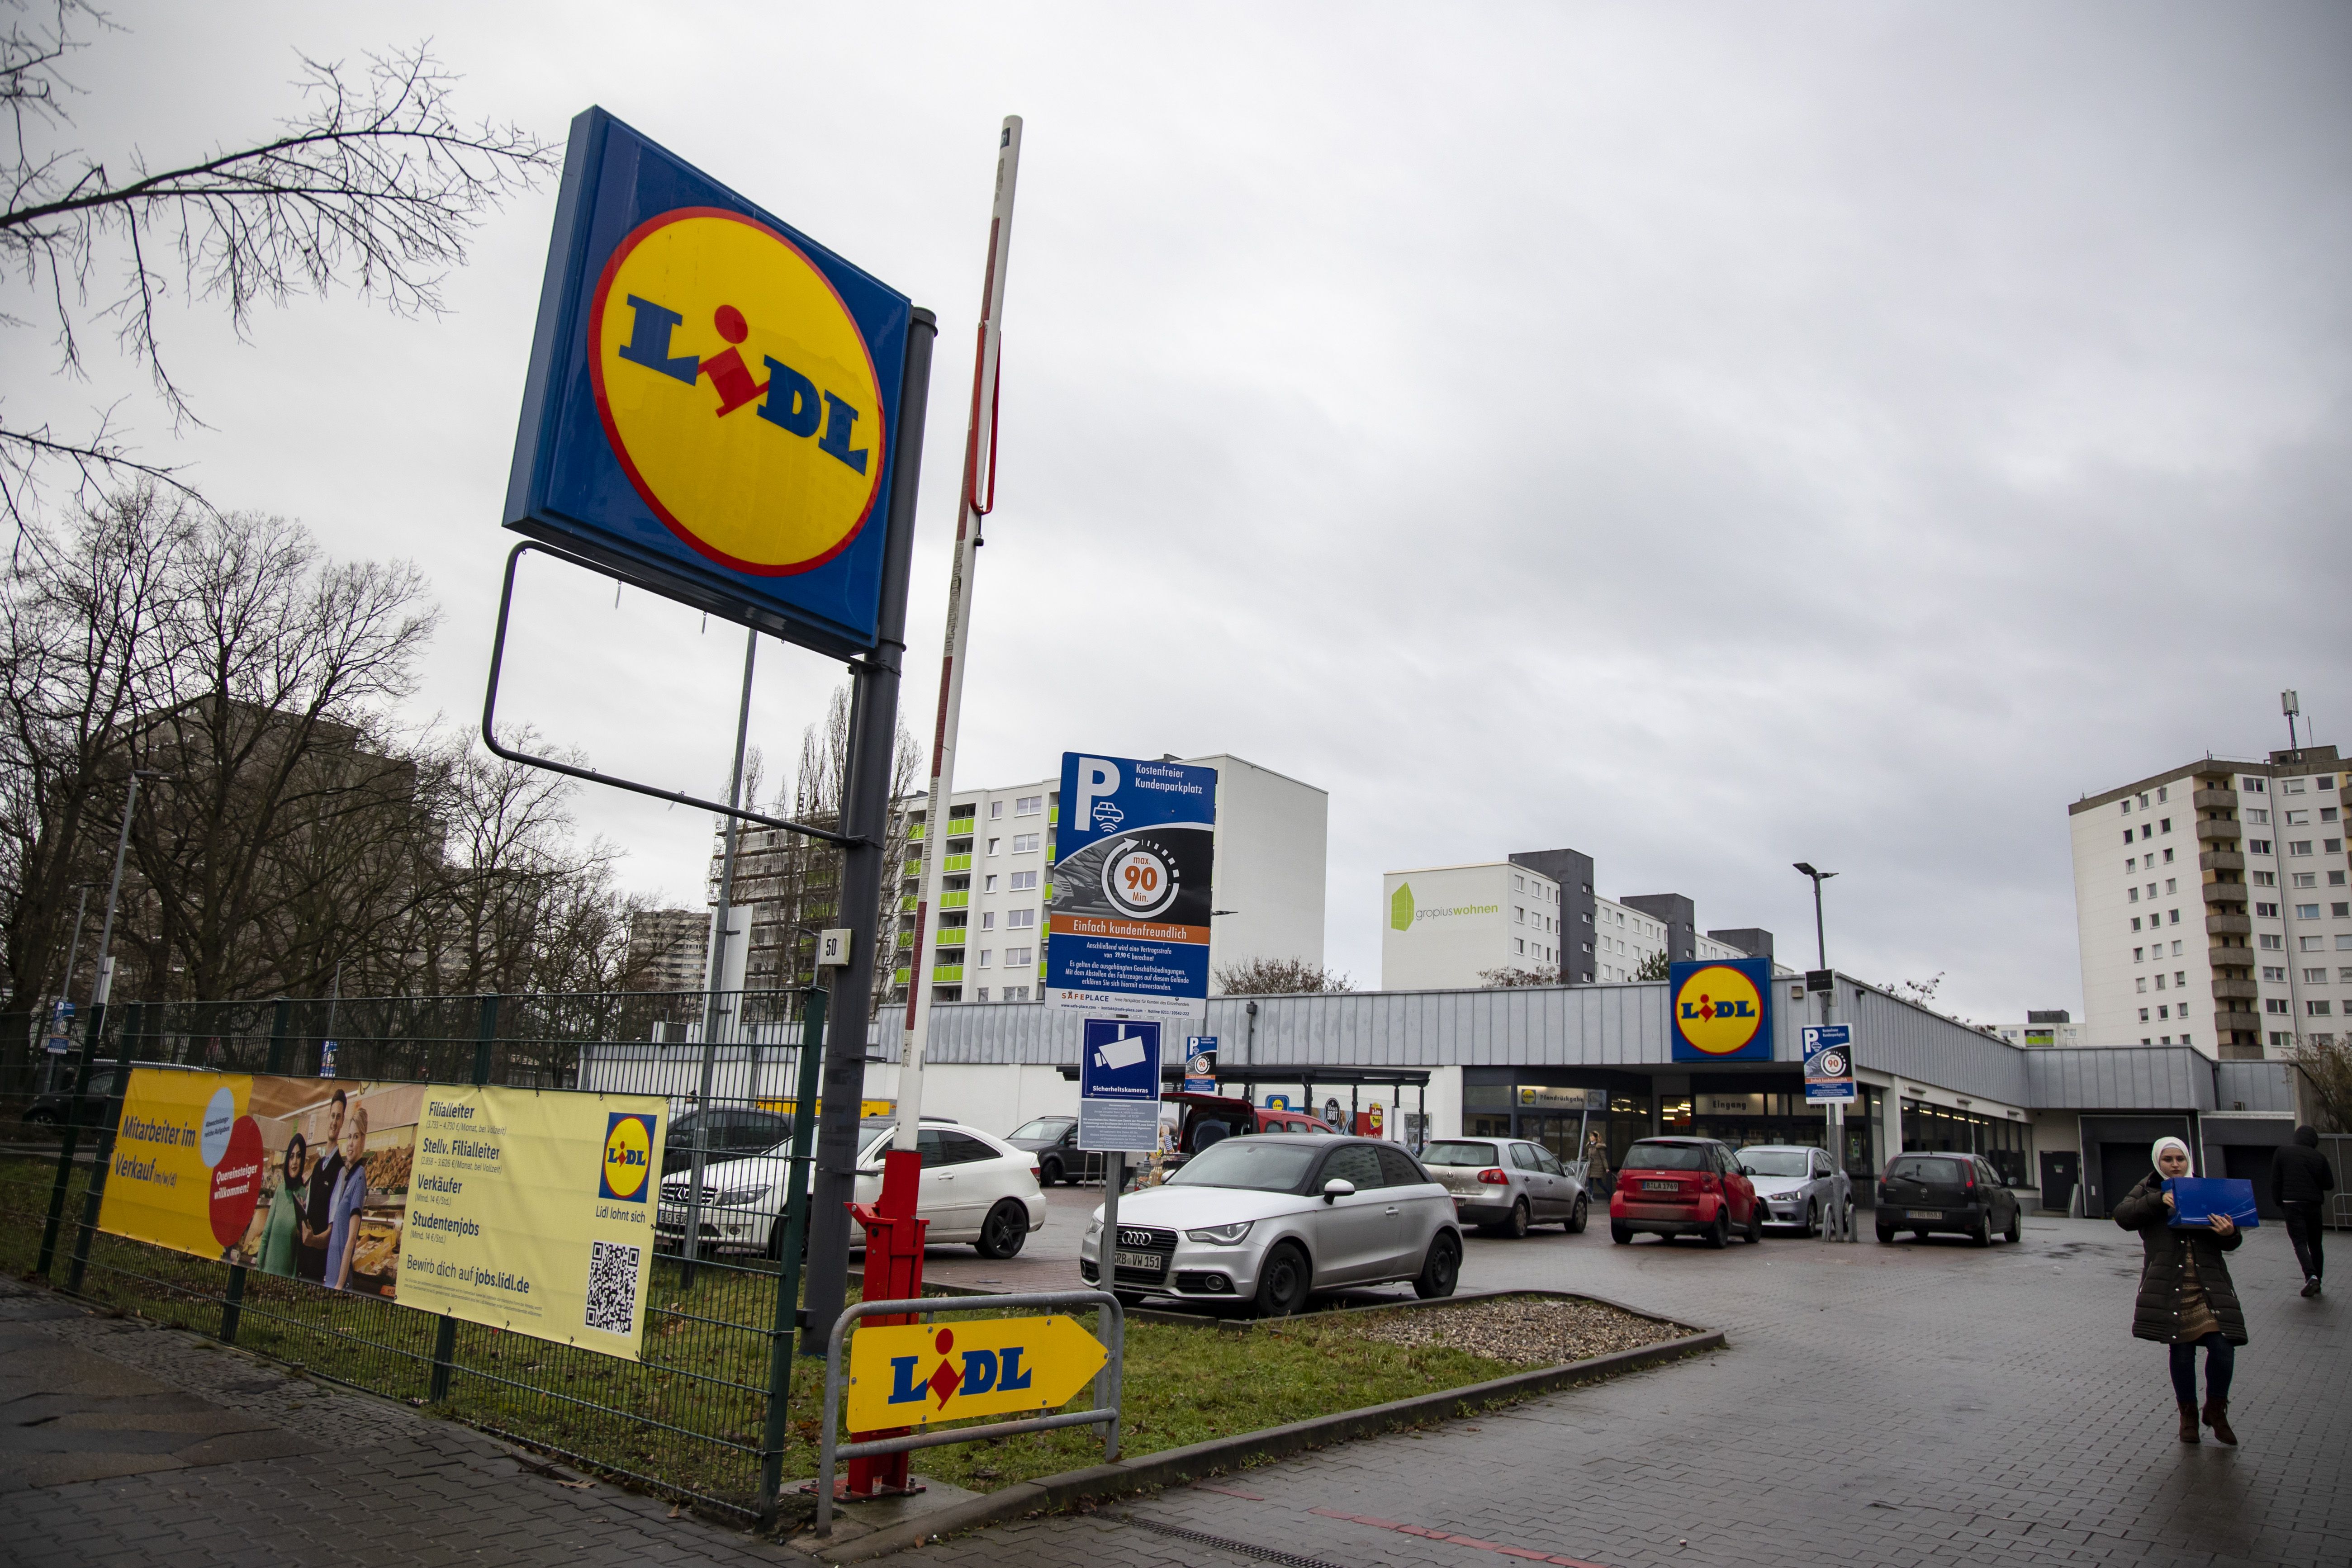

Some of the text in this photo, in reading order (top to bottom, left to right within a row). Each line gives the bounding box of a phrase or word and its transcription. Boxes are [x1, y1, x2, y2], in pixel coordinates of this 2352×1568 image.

[1136, 764, 1184, 778] Kostenfreier
[1074, 757, 1120, 831] P
[1135, 778, 1202, 794] Kundenparkplatz
[1124, 865, 1157, 891] 90
[1132, 892, 1148, 902] Min.
[1416, 904, 1498, 921] gropiuswohnen
[1073, 919, 1186, 939] Einfach kundenfreundlich
[826, 938, 837, 956] 50
[1086, 942, 1117, 950] Anschließend
[1140, 946, 1172, 955] Vertragsstrafe
[1100, 963, 1132, 971] ausgehängten
[1133, 965, 1185, 976] Geschäftsbedingungen.
[1117, 972, 1143, 981] Fahrzeuges
[1170, 976, 1189, 984] Gelände
[1138, 982, 1171, 990] einverstanden.
[1062, 993, 1109, 1002] SAFEPLACE
[1189, 1037, 1199, 1055] P
[1804, 1029, 1819, 1053] P
[429, 1101, 475, 1118] Filialleiter
[1713, 1100, 1746, 1110] Eingang
[1327, 1111, 1338, 1121] BROT
[122, 1115, 196, 1147] Mitarbeiter im
[426, 1120, 438, 1129] (3.733
[487, 1125, 507, 1136] Vollzeit)
[423, 1137, 500, 1160] Stellv. Filialleiter
[116, 1152, 177, 1189] Verkauf (m/w/d)
[216, 1163, 258, 1185] Quereinsteiger
[437, 1158, 450, 1167] 3.626
[483, 1164, 502, 1175] Vollzeit)
[214, 1181, 250, 1200] willkommen!
[418, 1174, 463, 1194] Verkäufer
[415, 1193, 451, 1207] (Mind. 14 €/Std.)
[596, 1205, 645, 1223] Lidl lohnt sich
[412, 1210, 479, 1237] Studentenjobs
[410, 1229, 424, 1240] (Mind.
[431, 1233, 446, 1245] €/Std.)
[1133, 1255, 1143, 1266] VW
[1144, 1256, 1159, 1268] 151
[407, 1254, 435, 1274] Bewirb
[436, 1260, 456, 1279] dich
[459, 1266, 474, 1282] auf
[474, 1267, 530, 1293] jobs.lidl.de
